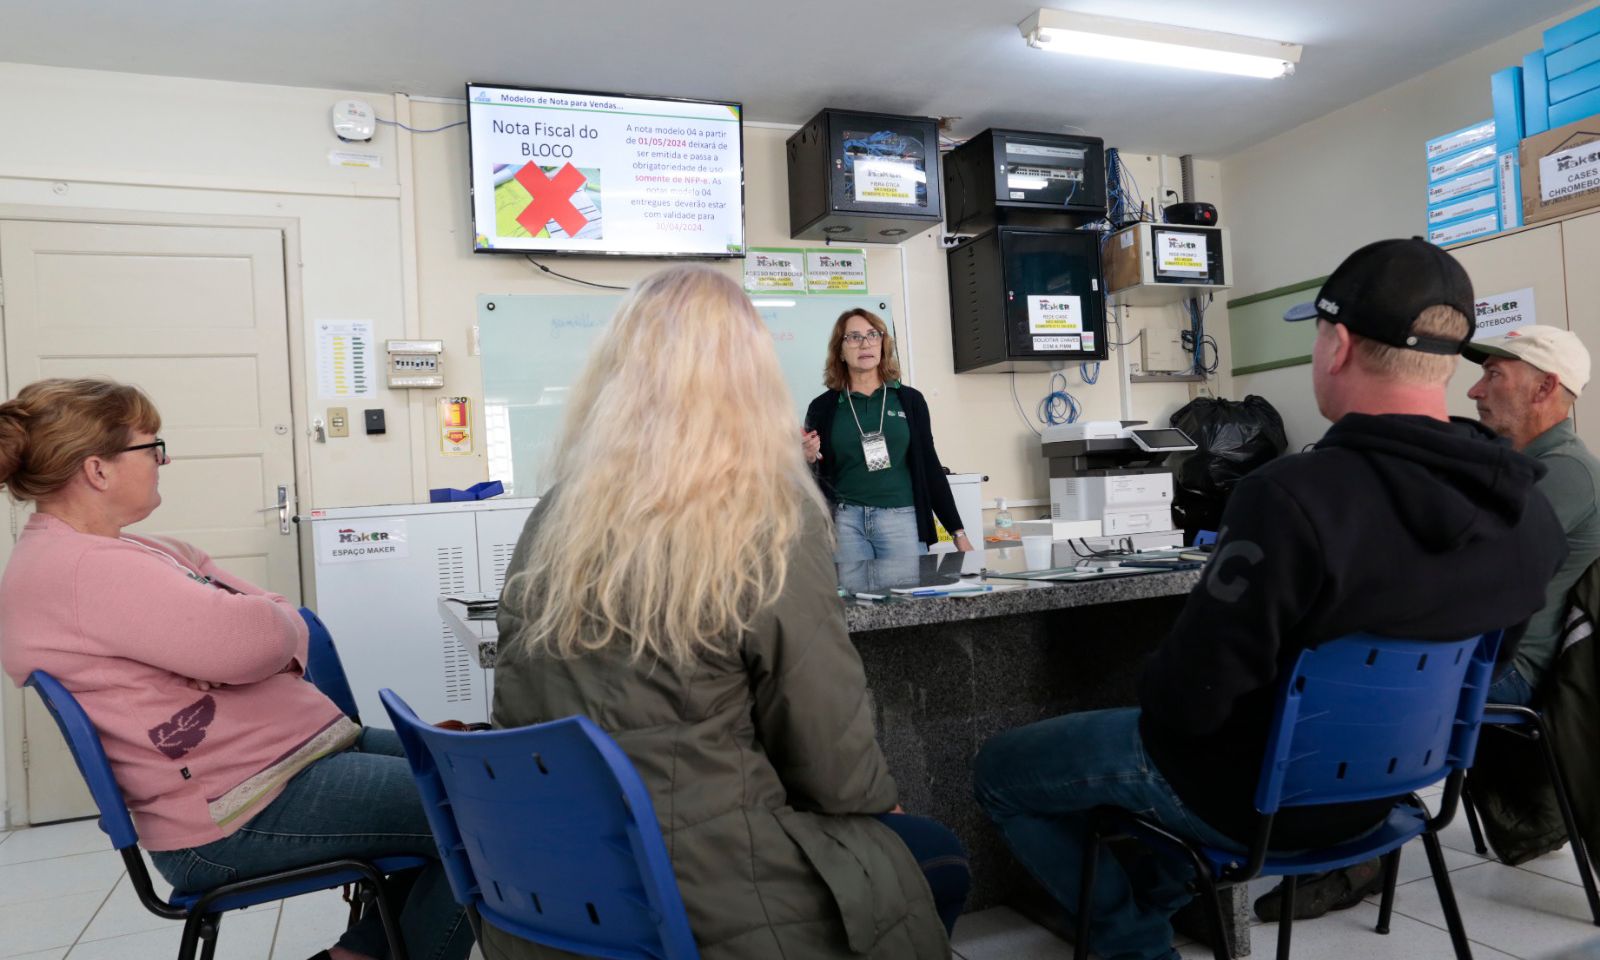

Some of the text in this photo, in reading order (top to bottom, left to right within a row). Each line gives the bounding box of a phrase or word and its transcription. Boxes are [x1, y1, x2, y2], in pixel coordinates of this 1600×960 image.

[500, 94, 535, 104] Modelos
[538, 96, 548, 104] de
[550, 97, 569, 106] Nota
[570, 100, 588, 108] para
[493, 119, 599, 140] Nota Fiscal do
[626, 124, 632, 132] A
[655, 127, 685, 136] modelo
[686, 128, 697, 136] 04
[705, 130, 727, 139] partir
[625, 136, 728, 150] de 01/05/2024 deixará de
[521, 142, 573, 158] BLOCO
[651, 150, 682, 159] emitida
[690, 153, 711, 162] passa
[632, 161, 696, 172] obrigatoriedade
[697, 164, 708, 173] de
[635, 174, 671, 183] somente
[672, 176, 682, 184] de
[712, 177, 722, 185] As
[1567, 167, 1598, 183] CASES
[701, 188, 712, 196] 04
[674, 200, 706, 208] deverão
[708, 201, 727, 209] estar
[643, 210, 715, 221] com validade para
[1475, 314, 1522, 329] NOTEBOOKS
[332, 546, 396, 557] ESPAÇO MAKER
